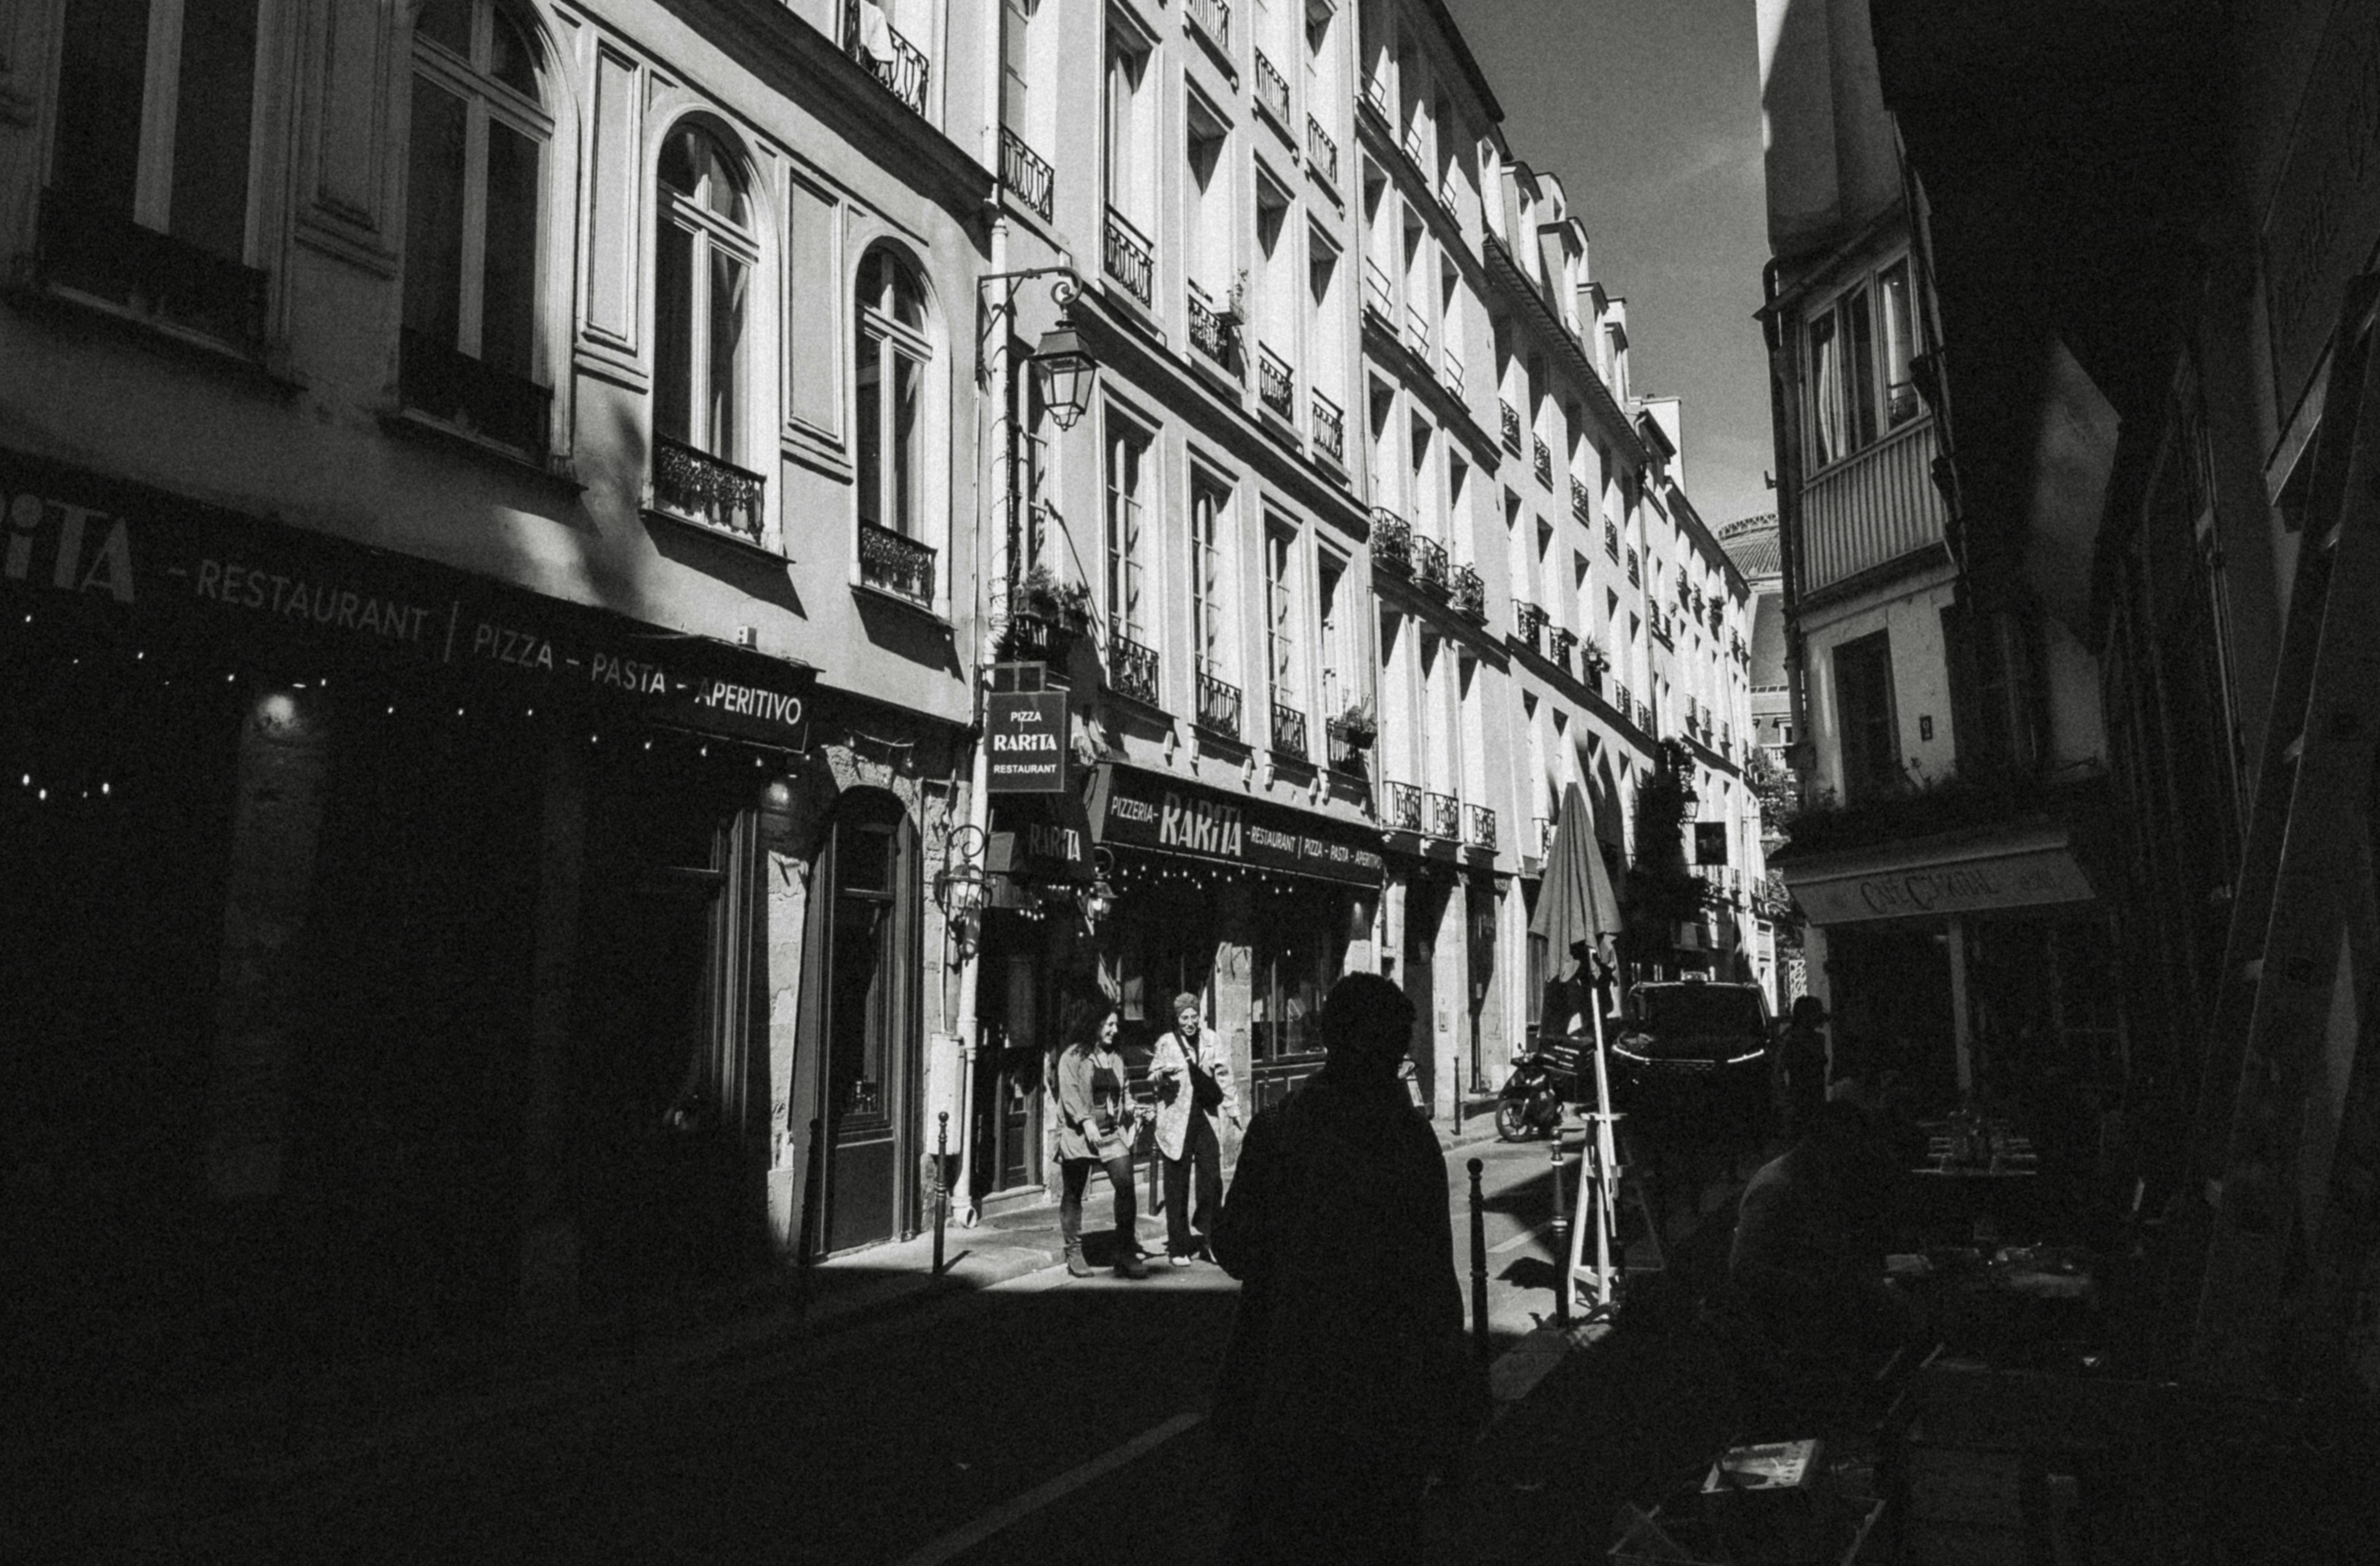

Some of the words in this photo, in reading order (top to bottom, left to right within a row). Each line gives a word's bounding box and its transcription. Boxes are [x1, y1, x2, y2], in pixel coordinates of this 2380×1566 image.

[197, 559, 429, 642] RESTAURANT
[474, 623, 553, 670] PIZZA
[591, 652, 666, 694] PASTA
[694, 677, 802, 725] APERITIVO
[1010, 711, 1042, 722] PIZZA
[993, 763, 1057, 774] RESTAURANT
[1303, 838, 1323, 858] PIZZA
[1330, 844, 1348, 863] PASTA
